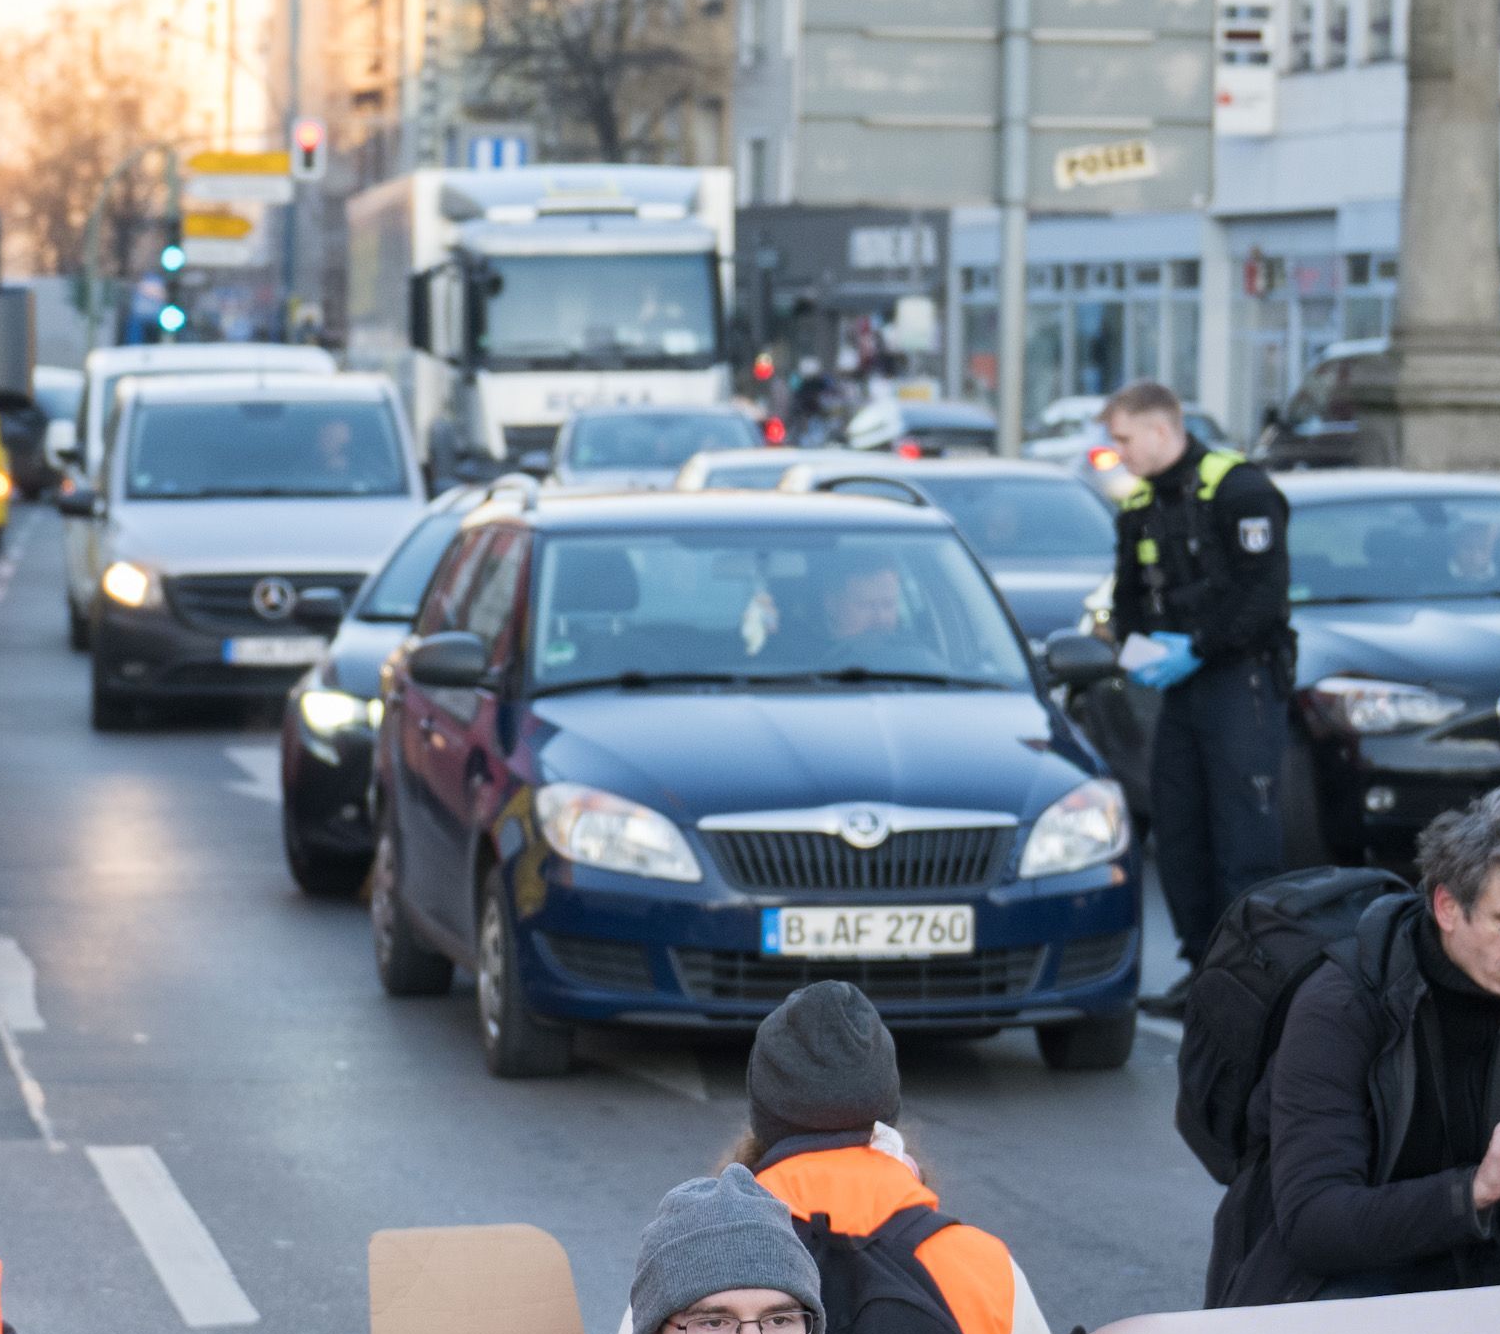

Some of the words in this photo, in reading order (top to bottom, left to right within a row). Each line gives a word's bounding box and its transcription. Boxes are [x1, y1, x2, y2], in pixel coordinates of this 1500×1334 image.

[784, 916, 805, 945] B
[832, 914, 874, 945] AF
[886, 912, 967, 945] 2760
